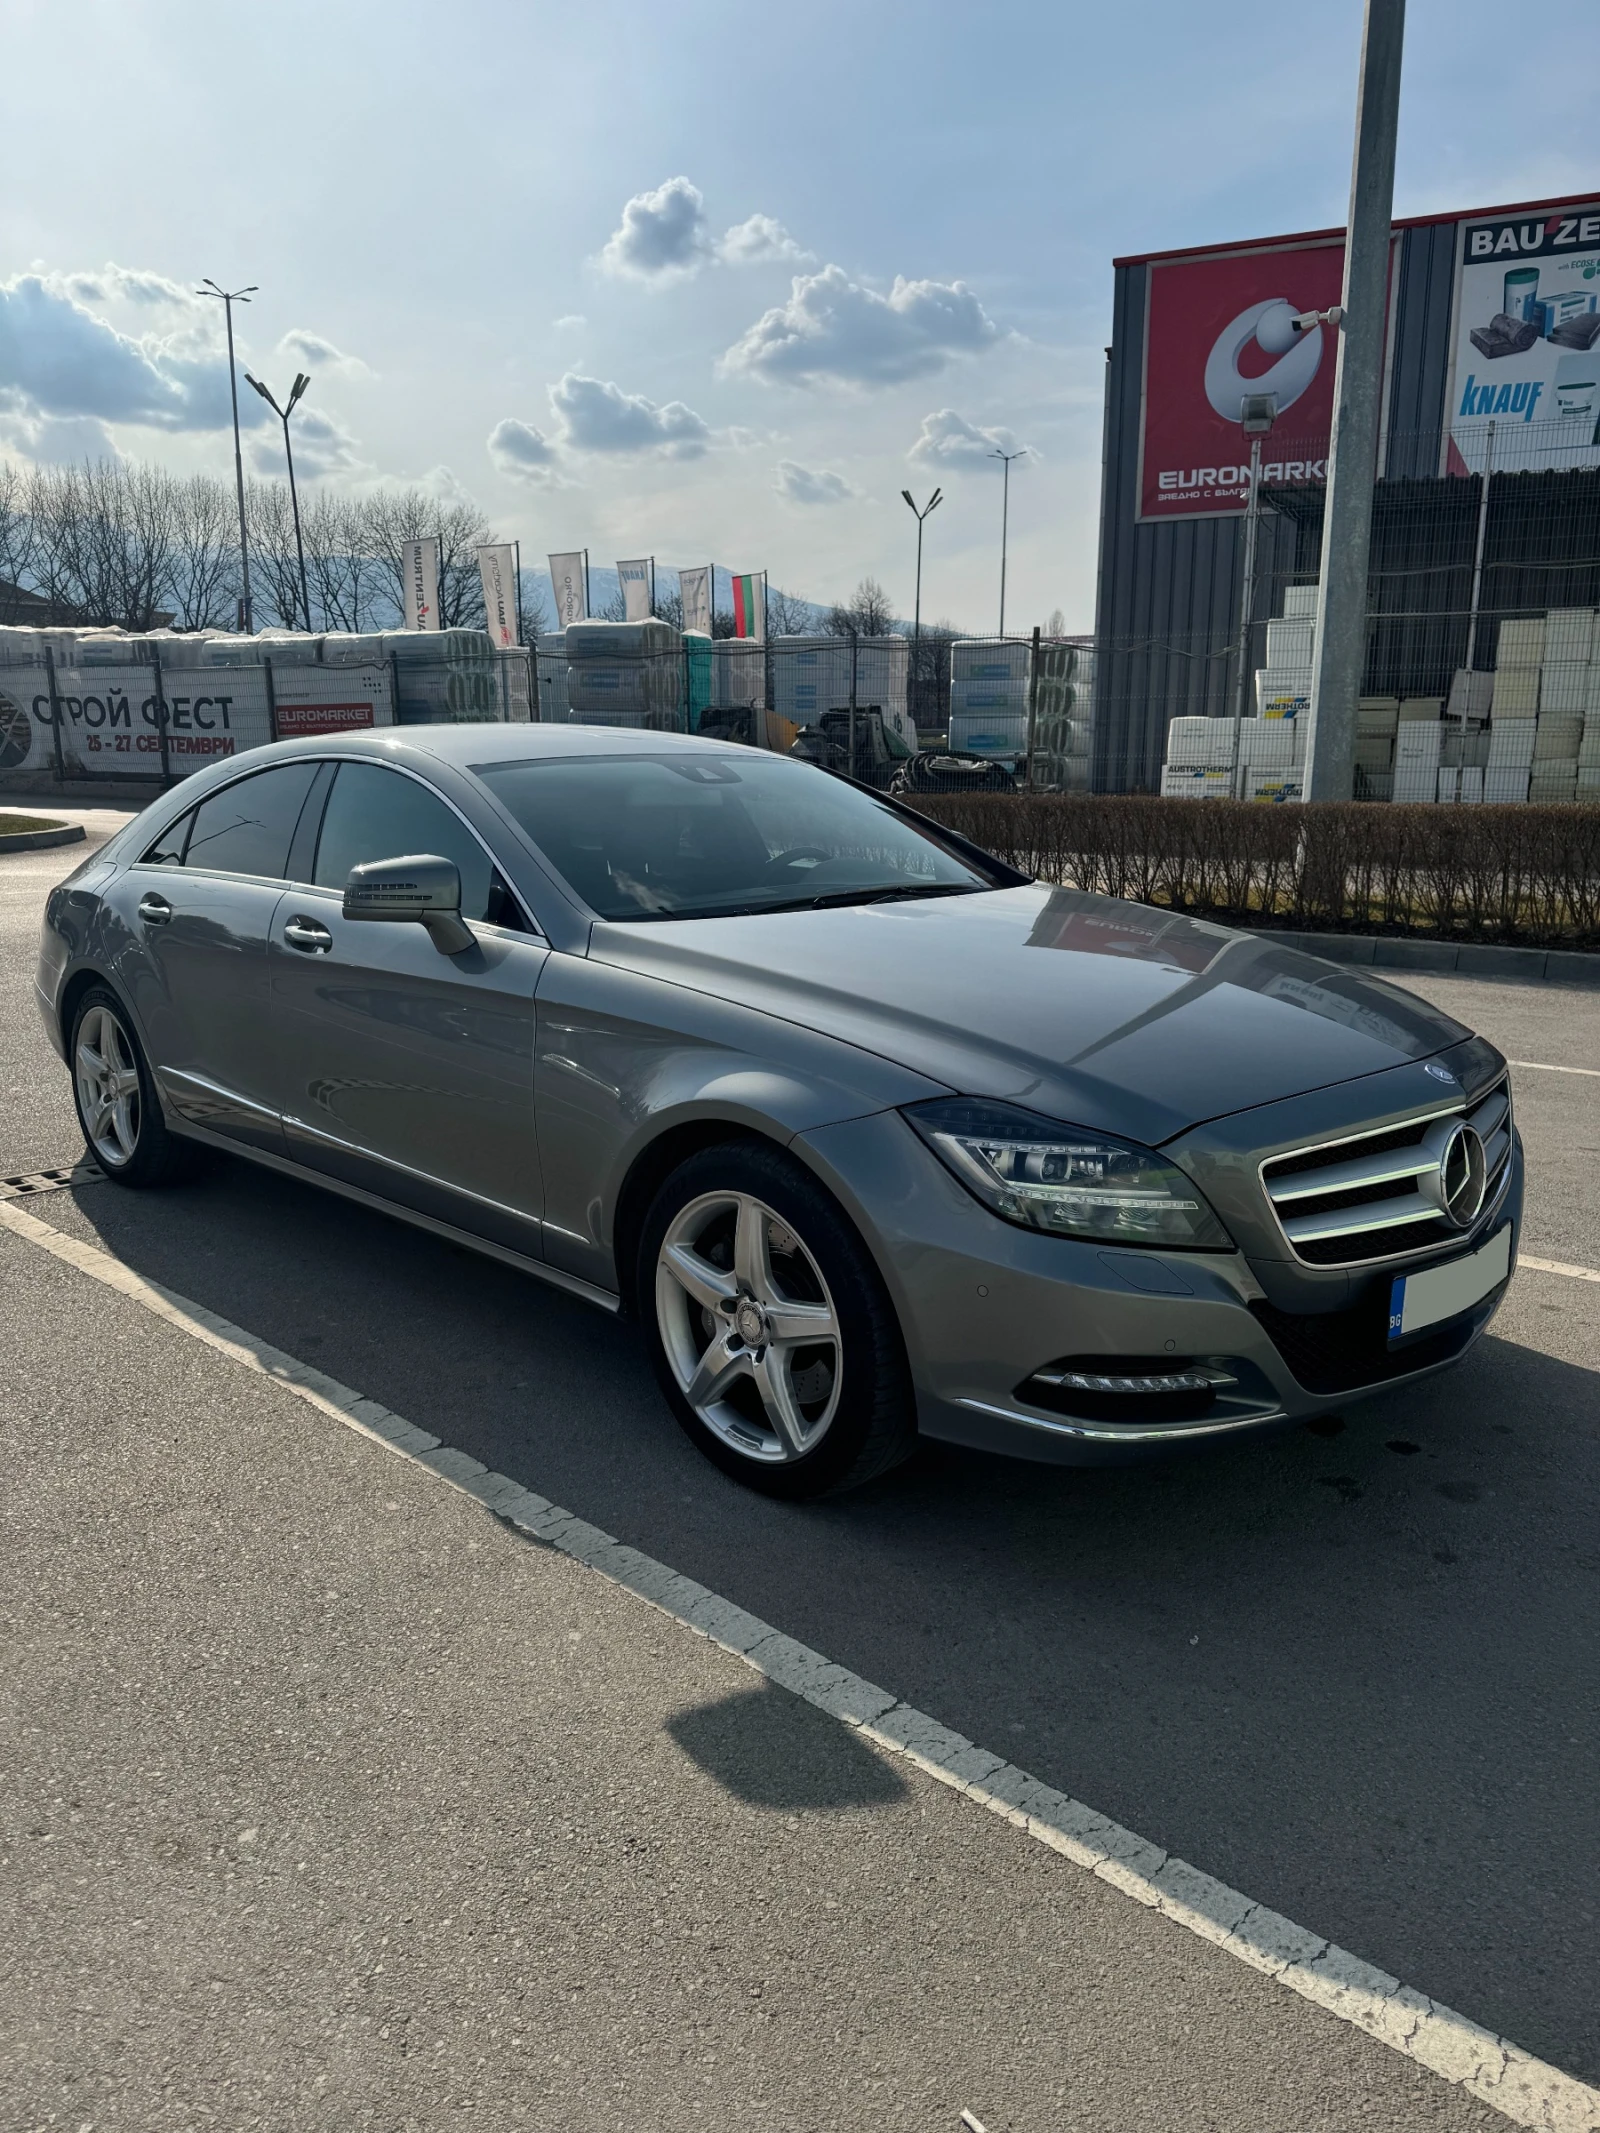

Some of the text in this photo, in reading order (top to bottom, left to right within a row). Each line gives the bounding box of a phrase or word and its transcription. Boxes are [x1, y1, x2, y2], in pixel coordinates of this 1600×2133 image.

[1158, 459, 1329, 490] EUROMARK
[142, 695, 233, 730] ФЕСТ
[278, 708, 370, 722] EUROMARKET
[86, 735, 102, 751] 25
[115, 735, 131, 752] 27
[1390, 1314, 1401, 1329] BG
